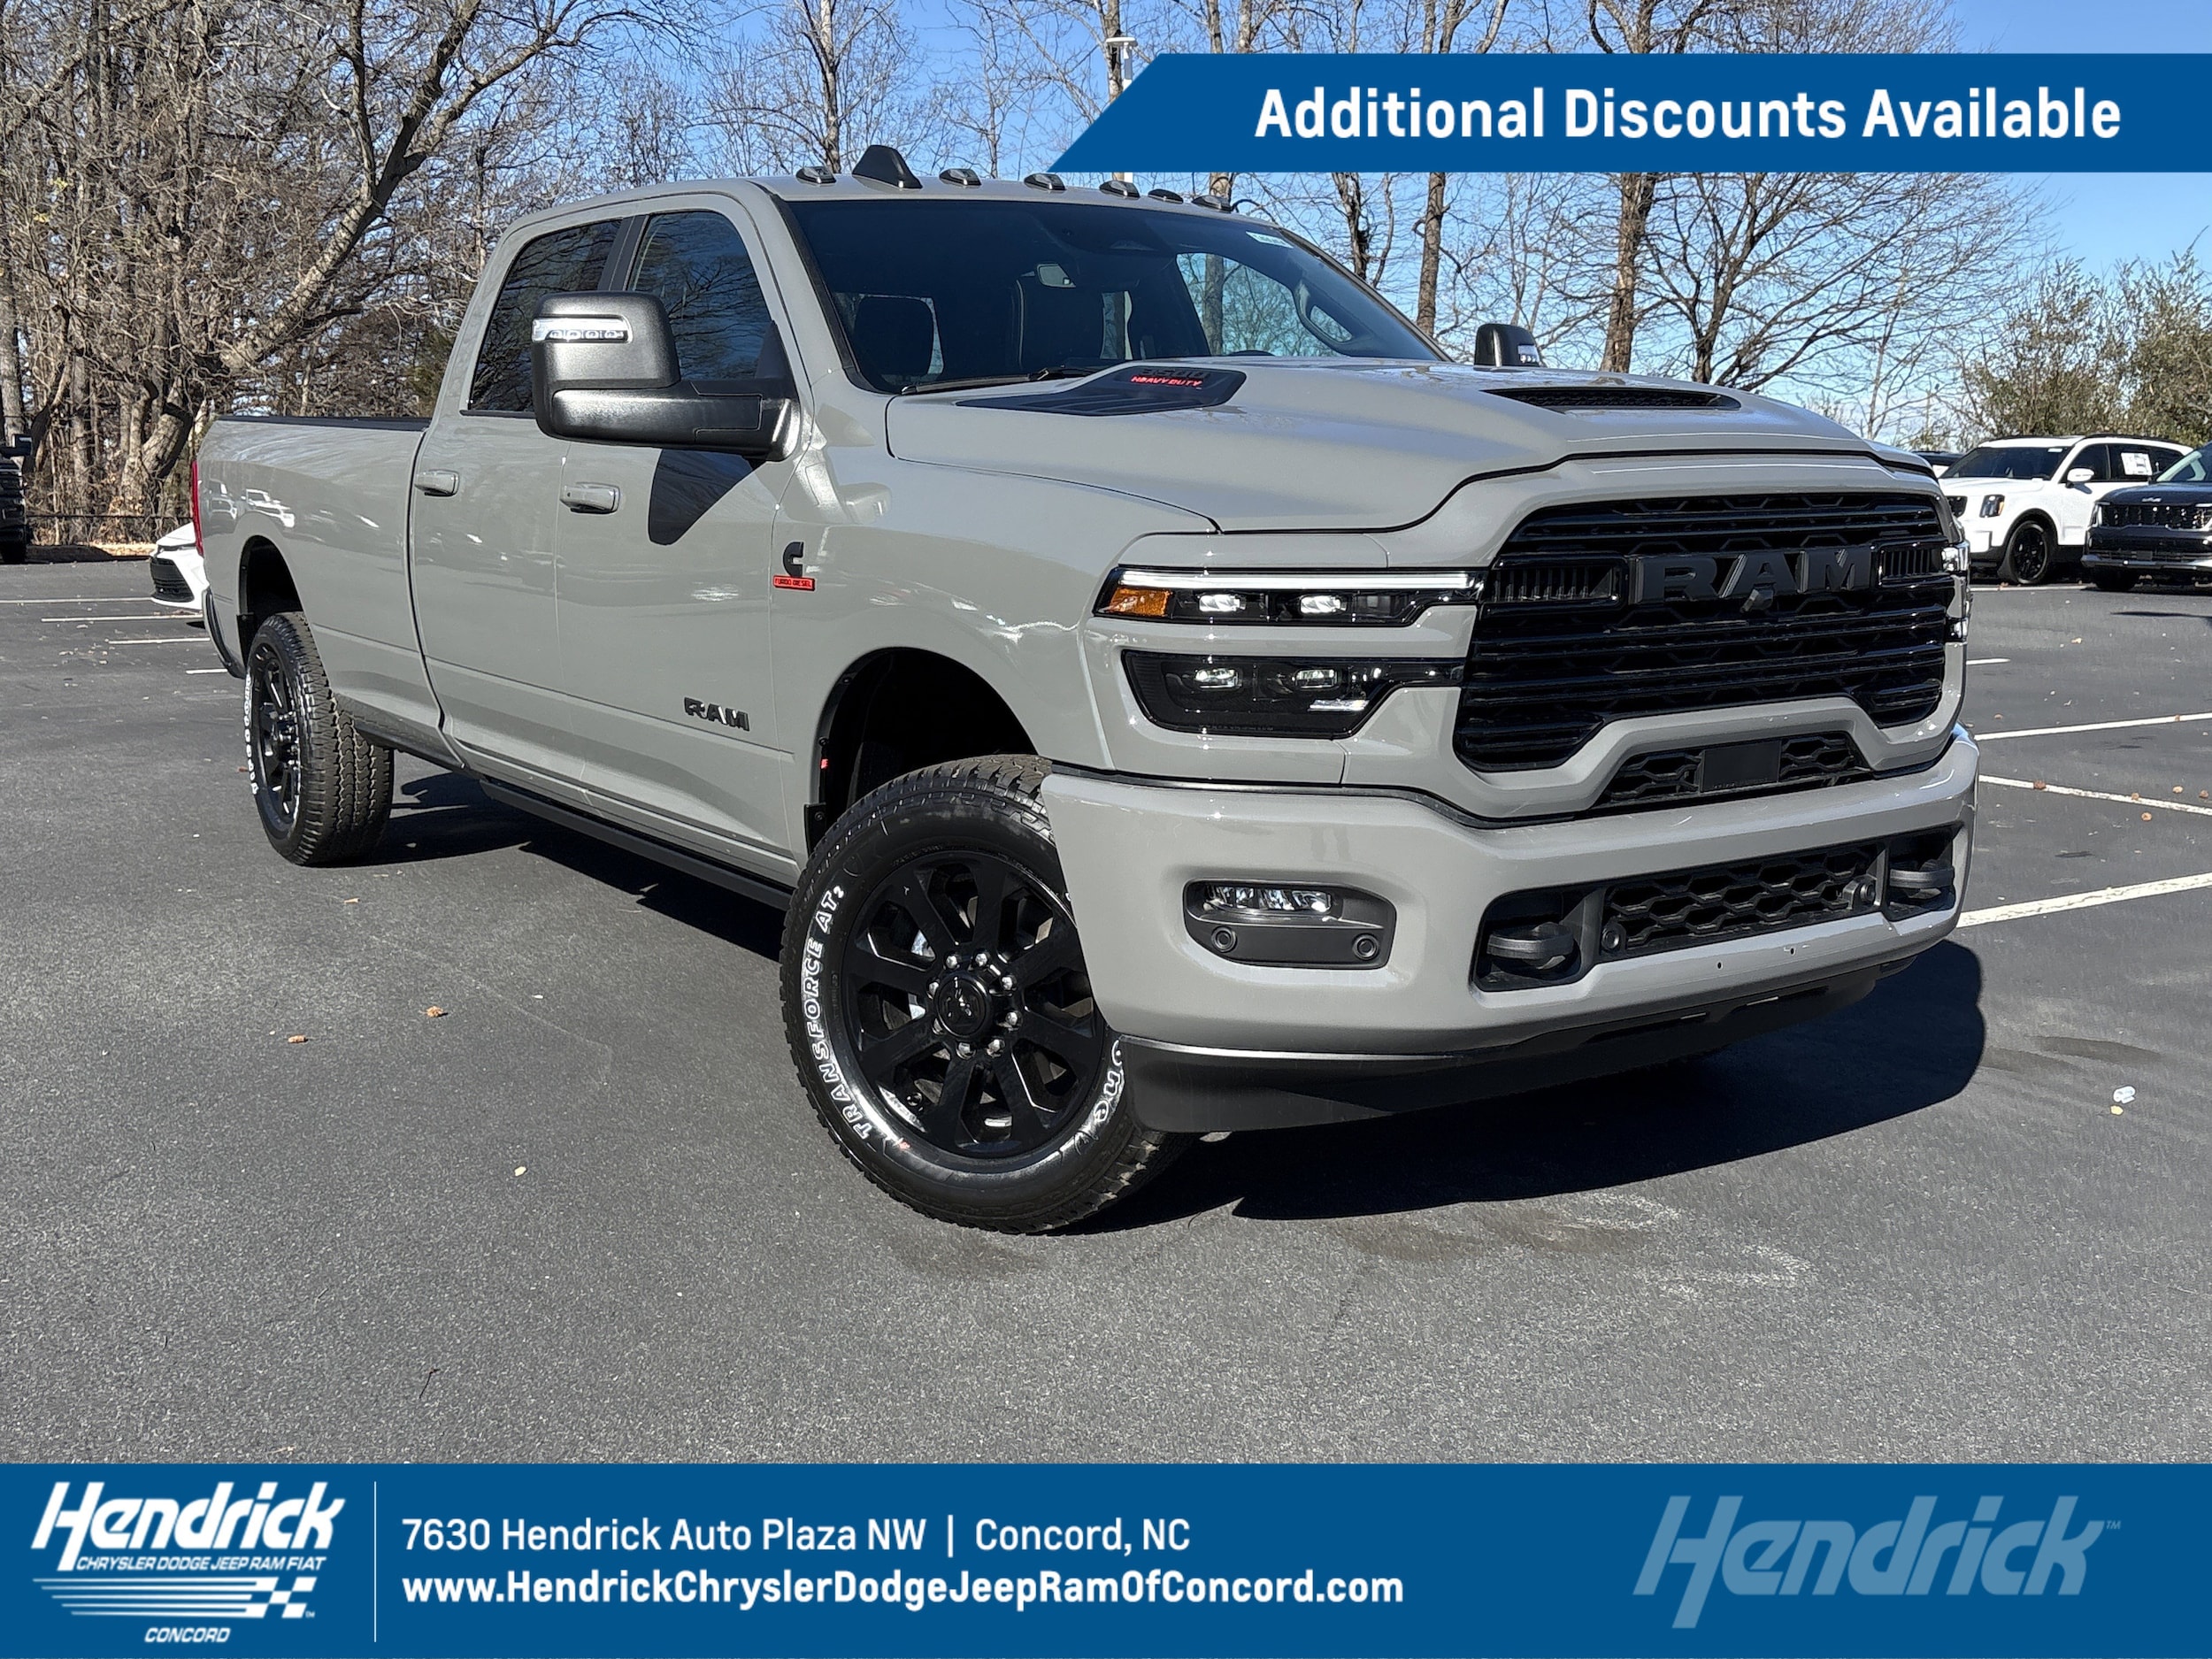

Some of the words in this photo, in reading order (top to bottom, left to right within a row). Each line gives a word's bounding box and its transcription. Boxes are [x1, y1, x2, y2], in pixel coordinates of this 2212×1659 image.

[1634, 546, 1872, 603] RAM
[683, 696, 750, 732] RAM
[803, 937, 873, 1140] TRANSFORCE
